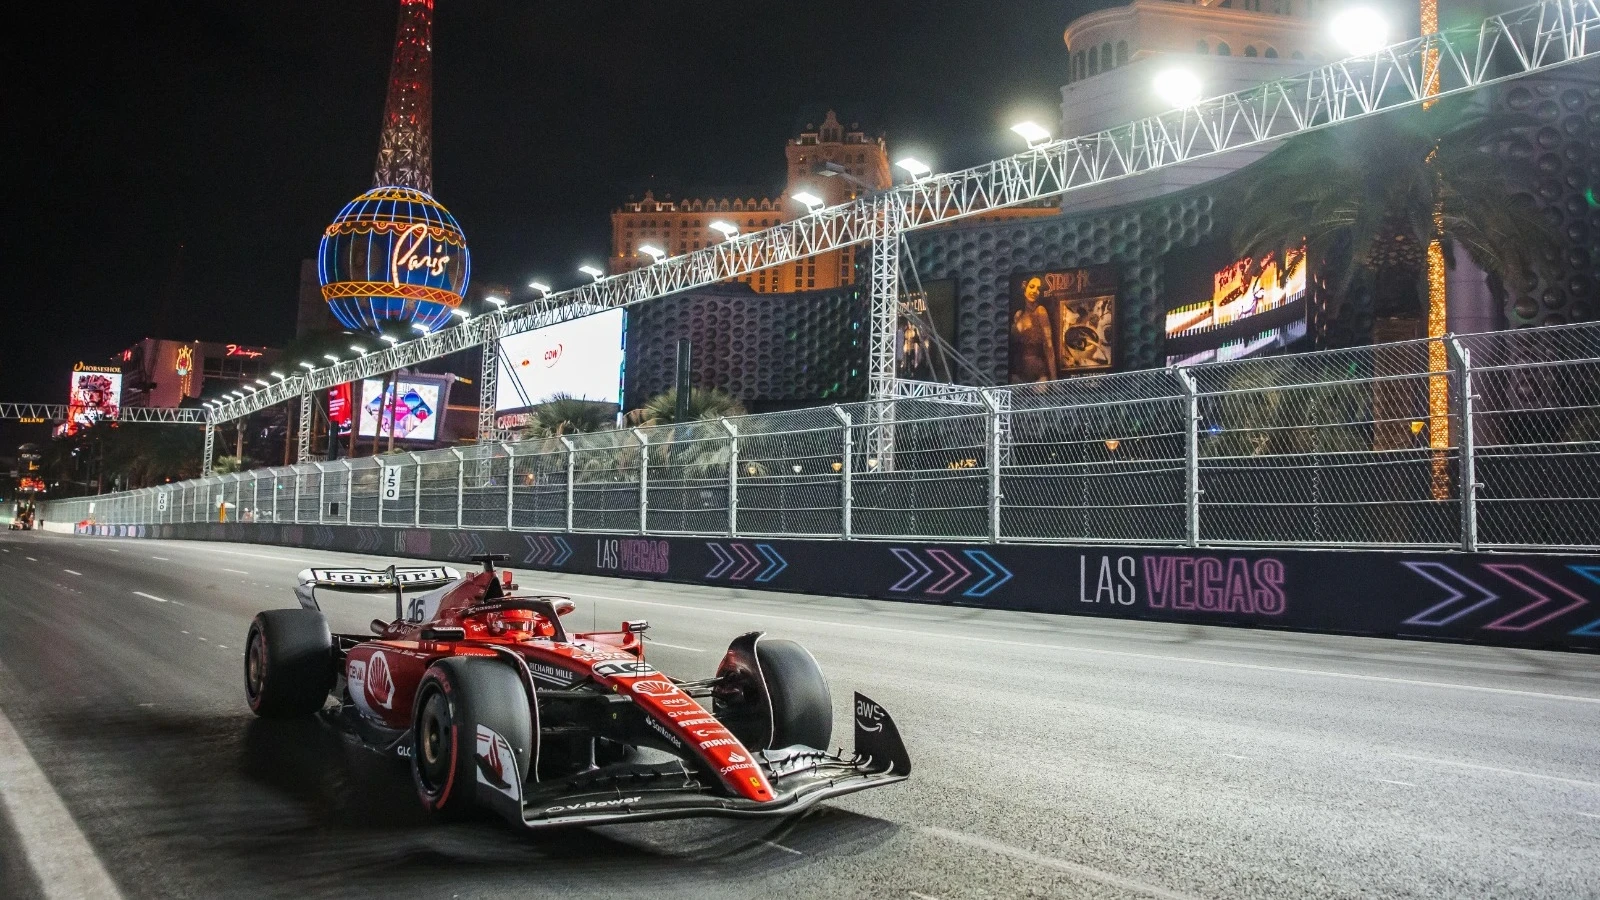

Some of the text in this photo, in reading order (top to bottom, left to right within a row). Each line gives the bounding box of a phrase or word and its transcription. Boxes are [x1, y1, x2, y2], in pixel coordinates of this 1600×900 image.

[392, 223, 450, 288] Paris
[544, 349, 559, 361] CDW
[83, 365, 121, 373] HORSESHOE
[385, 468, 396, 499] 150
[596, 538, 669, 573] LAS VEGAS
[1080, 554, 1286, 616] LAS VEGAS
[408, 598, 425, 623] 16
[529, 662, 573, 680] RICHARD MILLE
[594, 663, 655, 677] 16
[856, 700, 883, 721] aws
[651, 718, 682, 749] Santander
[566, 795, 642, 810] V-Power
